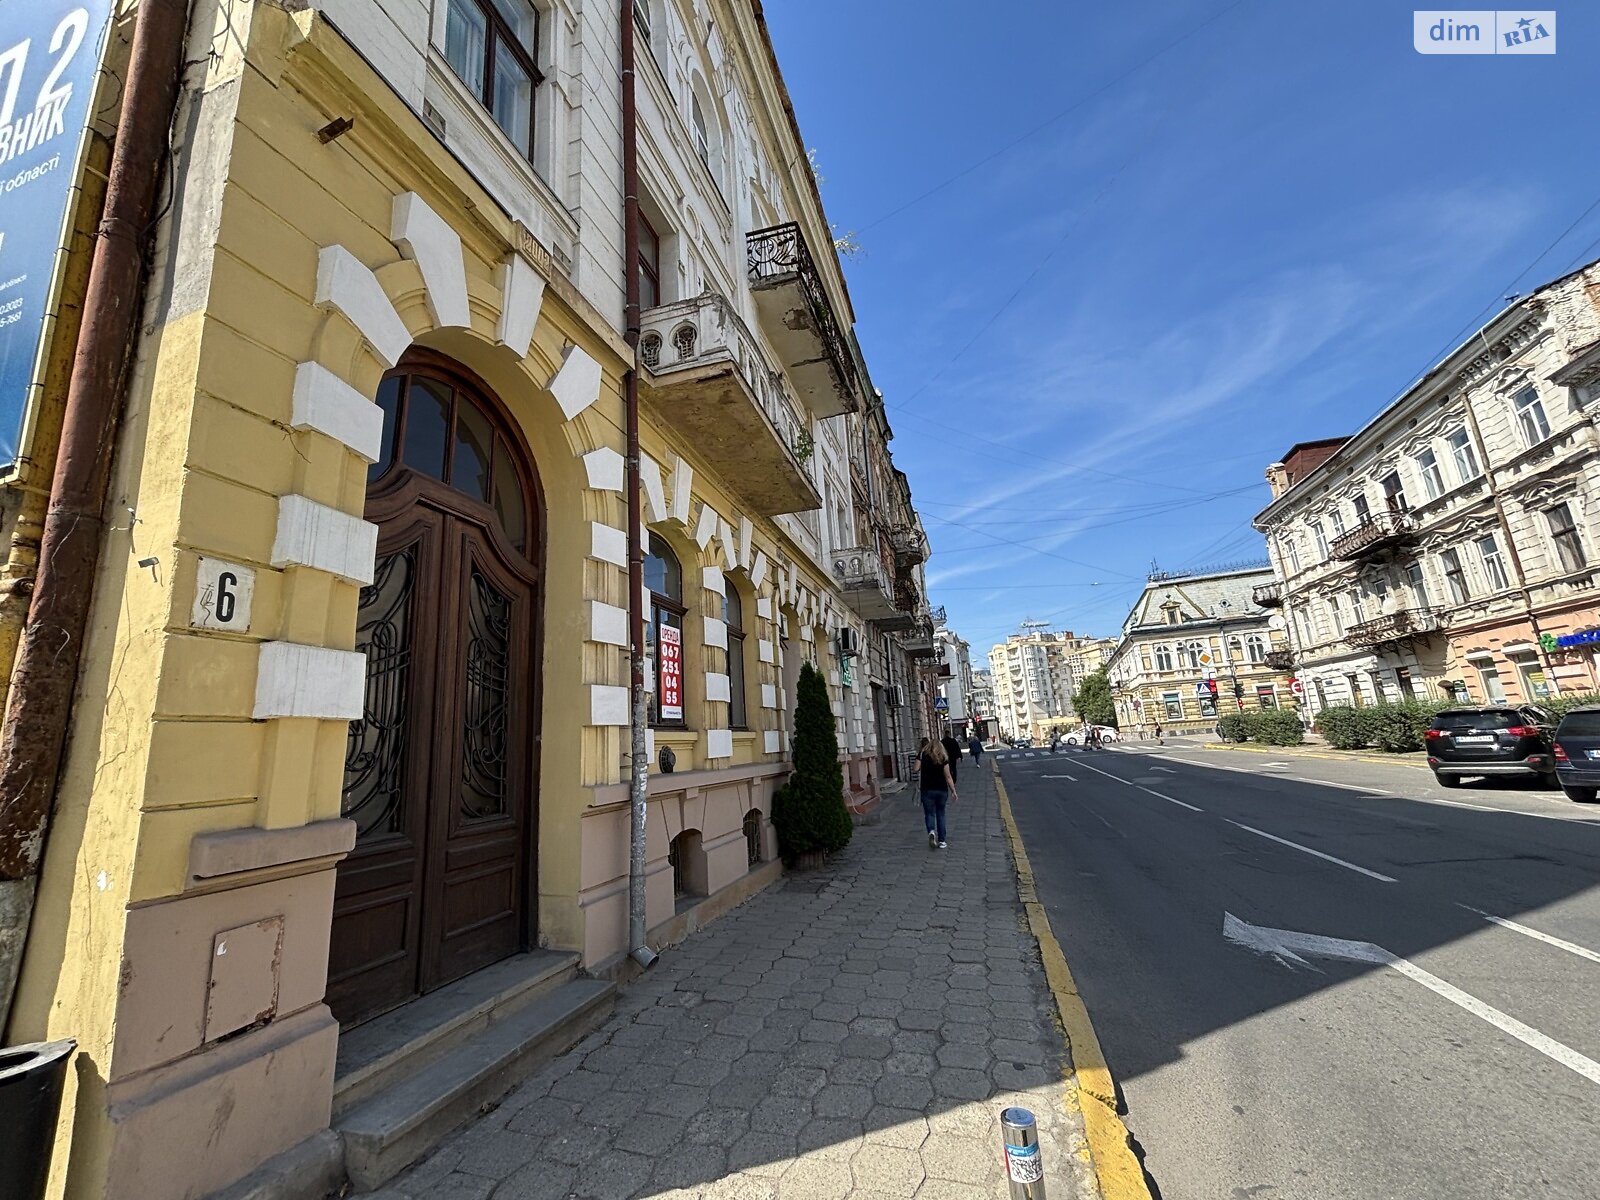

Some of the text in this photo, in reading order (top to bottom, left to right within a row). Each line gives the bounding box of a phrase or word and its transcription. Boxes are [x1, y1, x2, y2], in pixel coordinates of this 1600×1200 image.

[35, 7, 89, 110] 2
[5, 152, 61, 192] області
[216, 571, 237, 623] 6
[662, 643, 679, 659] 067
[662, 659, 680, 675] 251
[665, 675, 678, 690] 04
[666, 690, 678, 704] 55
